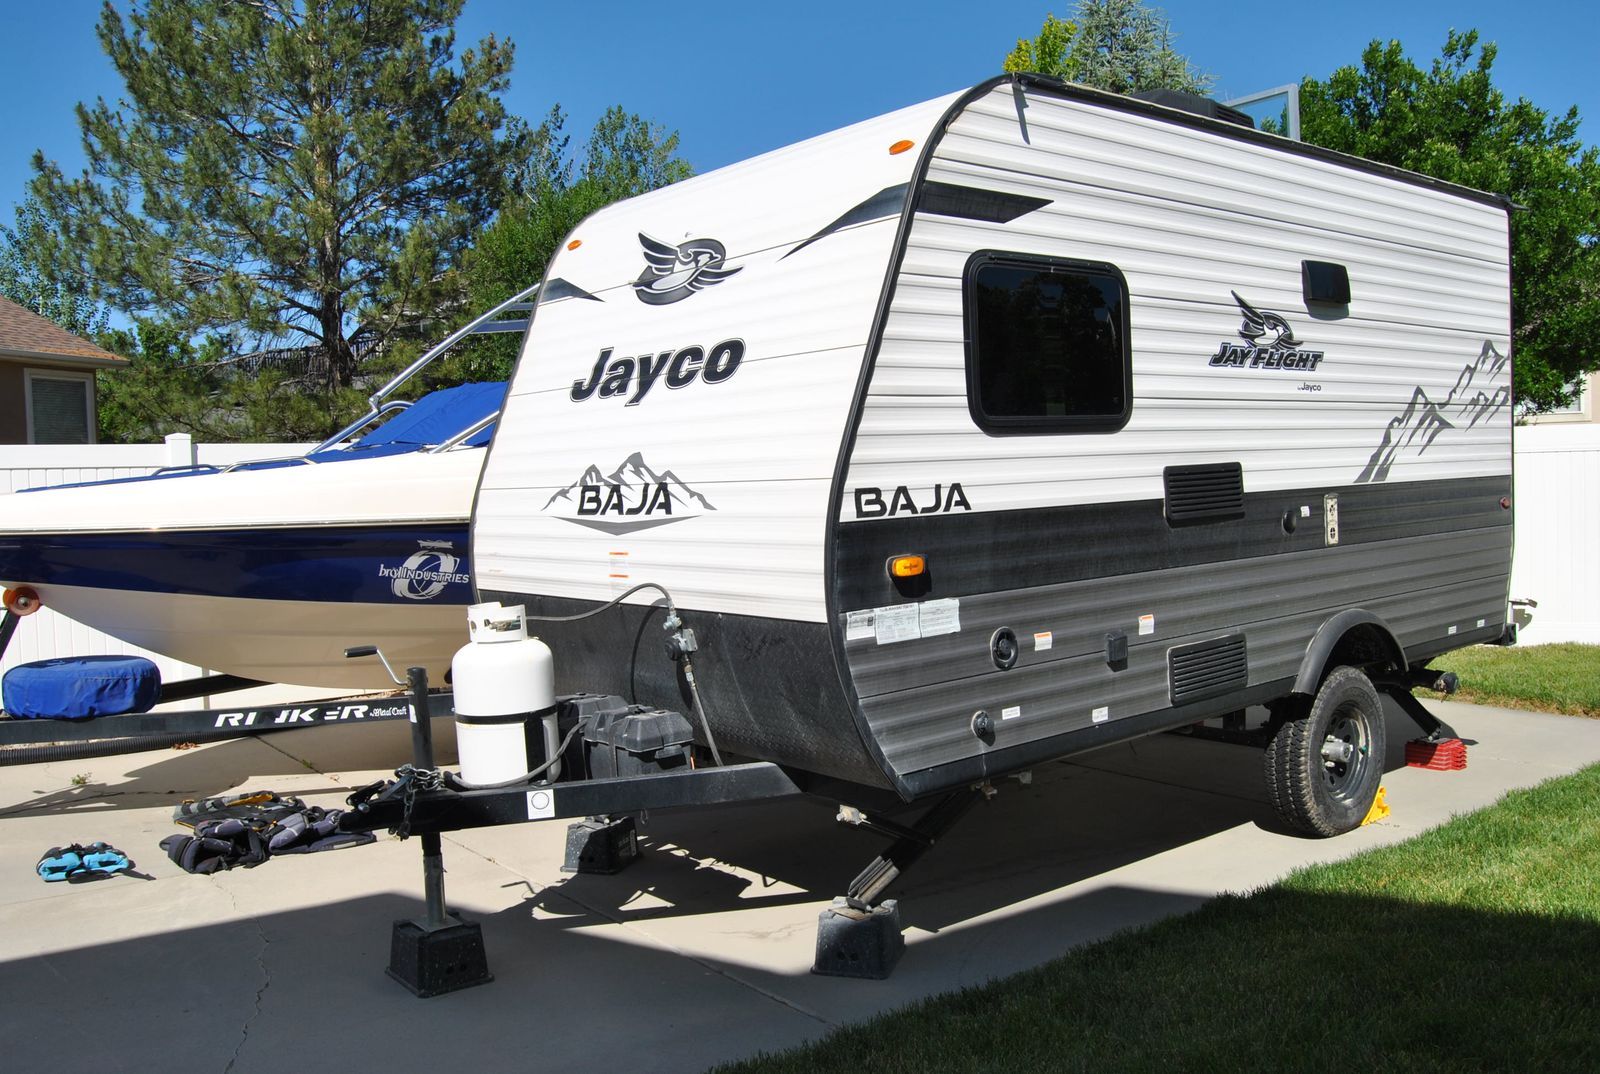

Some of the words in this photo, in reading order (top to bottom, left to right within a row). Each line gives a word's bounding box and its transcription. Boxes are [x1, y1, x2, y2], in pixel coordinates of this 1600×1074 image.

[570, 337, 746, 407] Jayco
[1209, 342, 1254, 368] JAY
[1250, 347, 1324, 371] FLIGHT
[1301, 381, 1322, 393] Jayco
[577, 481, 672, 516] BAJA
[855, 482, 972, 519] BAJA
